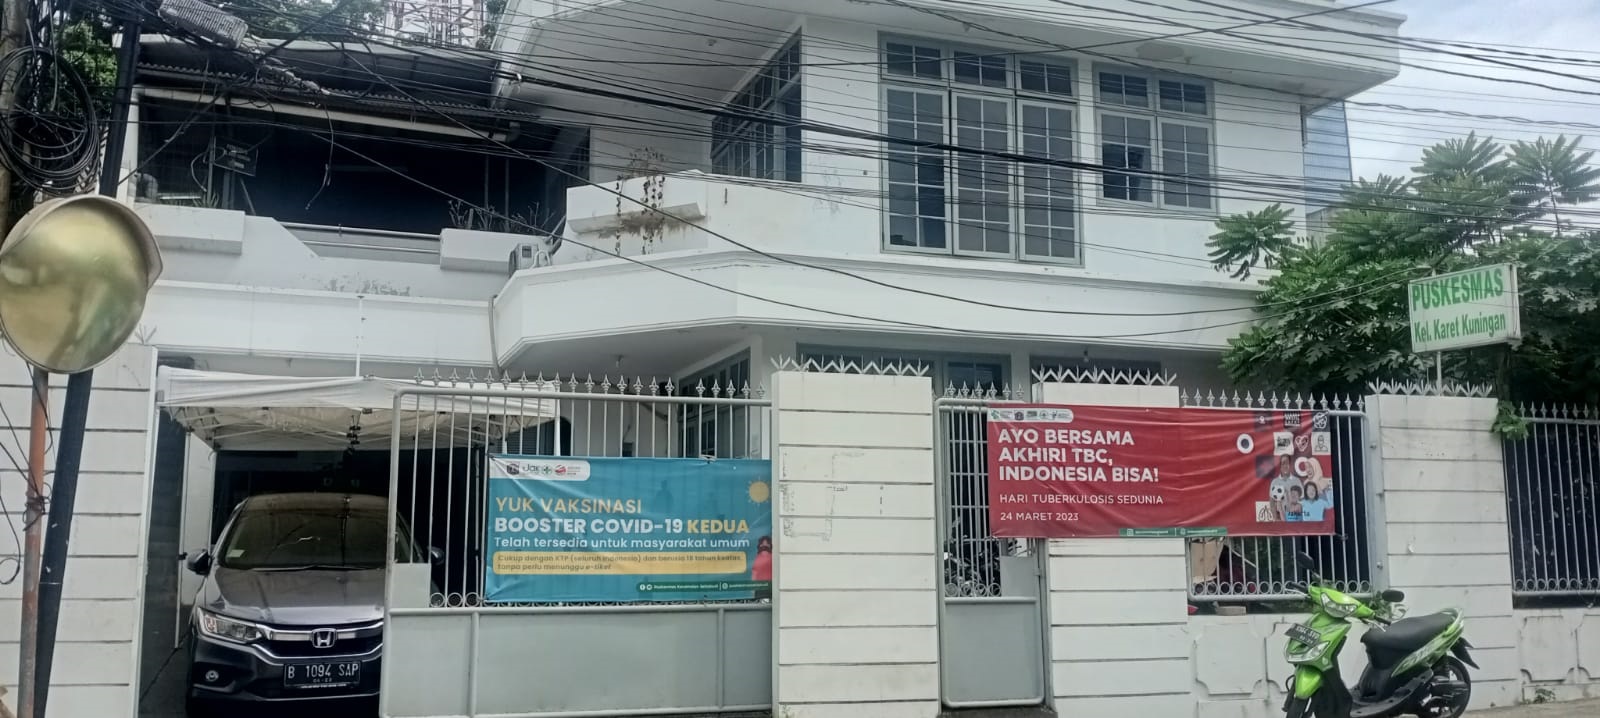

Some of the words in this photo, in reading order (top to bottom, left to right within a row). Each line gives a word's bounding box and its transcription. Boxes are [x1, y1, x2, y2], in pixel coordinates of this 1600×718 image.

[1411, 268, 1504, 311] PUSKESMAS
[1414, 321, 1432, 343] Kel.
[1433, 317, 1460, 340] Karet
[1461, 312, 1506, 337] Kuningan
[998, 429, 1039, 444] AYO
[1044, 429, 1135, 446] BERSAMA
[998, 447, 1067, 463] AKHIRI
[1071, 449, 1113, 466] TBC,
[999, 466, 1107, 482] INDONESIA
[1112, 468, 1159, 483] BISA!
[496, 496, 535, 512] YUK
[541, 498, 641, 513] VAKSINASI
[1000, 494, 1029, 504] HARI
[1032, 494, 1114, 504] TUBERKULOSIS
[1117, 495, 1164, 505] SEDUNIA
[1000, 512, 1013, 521] 24
[1015, 512, 1053, 521] MARET
[1055, 513, 1079, 521] 2023
[494, 517, 586, 533] BOOSTER
[590, 518, 683, 534] COVID-19
[687, 519, 750, 534] KEDUA
[495, 537, 530, 548] Telah
[534, 537, 588, 548] tersedia
[591, 537, 629, 548] untuk
[631, 537, 707, 551] masyarakat
[710, 539, 750, 549] umum
[497, 554, 524, 563] Cukup
[525, 554, 554, 563] dengan
[497, 563, 521, 571] tanpa
[522, 563, 542, 571] perlu
[543, 563, 584, 571] menunggu
[287, 665, 295, 679] B
[306, 664, 331, 677] 1094
[339, 663, 359, 676] SAP
